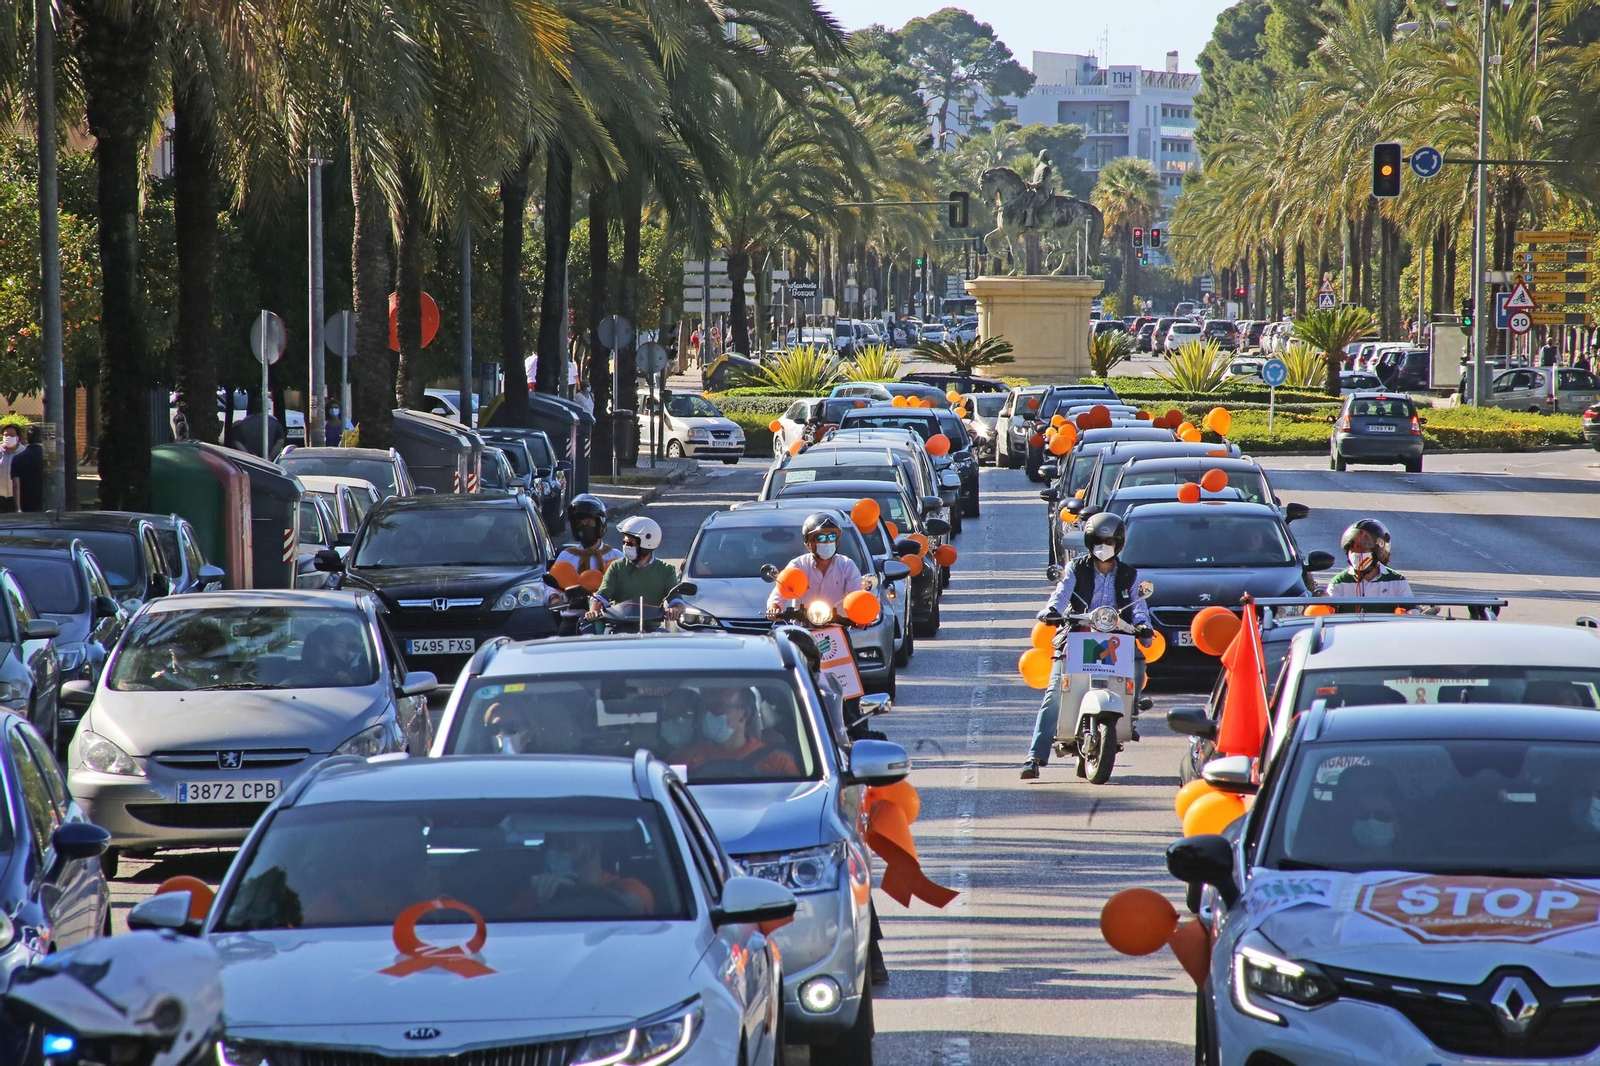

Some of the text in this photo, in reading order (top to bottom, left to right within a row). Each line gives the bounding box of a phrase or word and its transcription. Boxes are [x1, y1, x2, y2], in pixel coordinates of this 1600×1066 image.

[1513, 318, 1528, 327] 30
[413, 640, 472, 652] 5495 FXS
[189, 783, 276, 800] 3872 CPB
[1397, 884, 1580, 920] STOP
[410, 1028, 436, 1038] KIA
